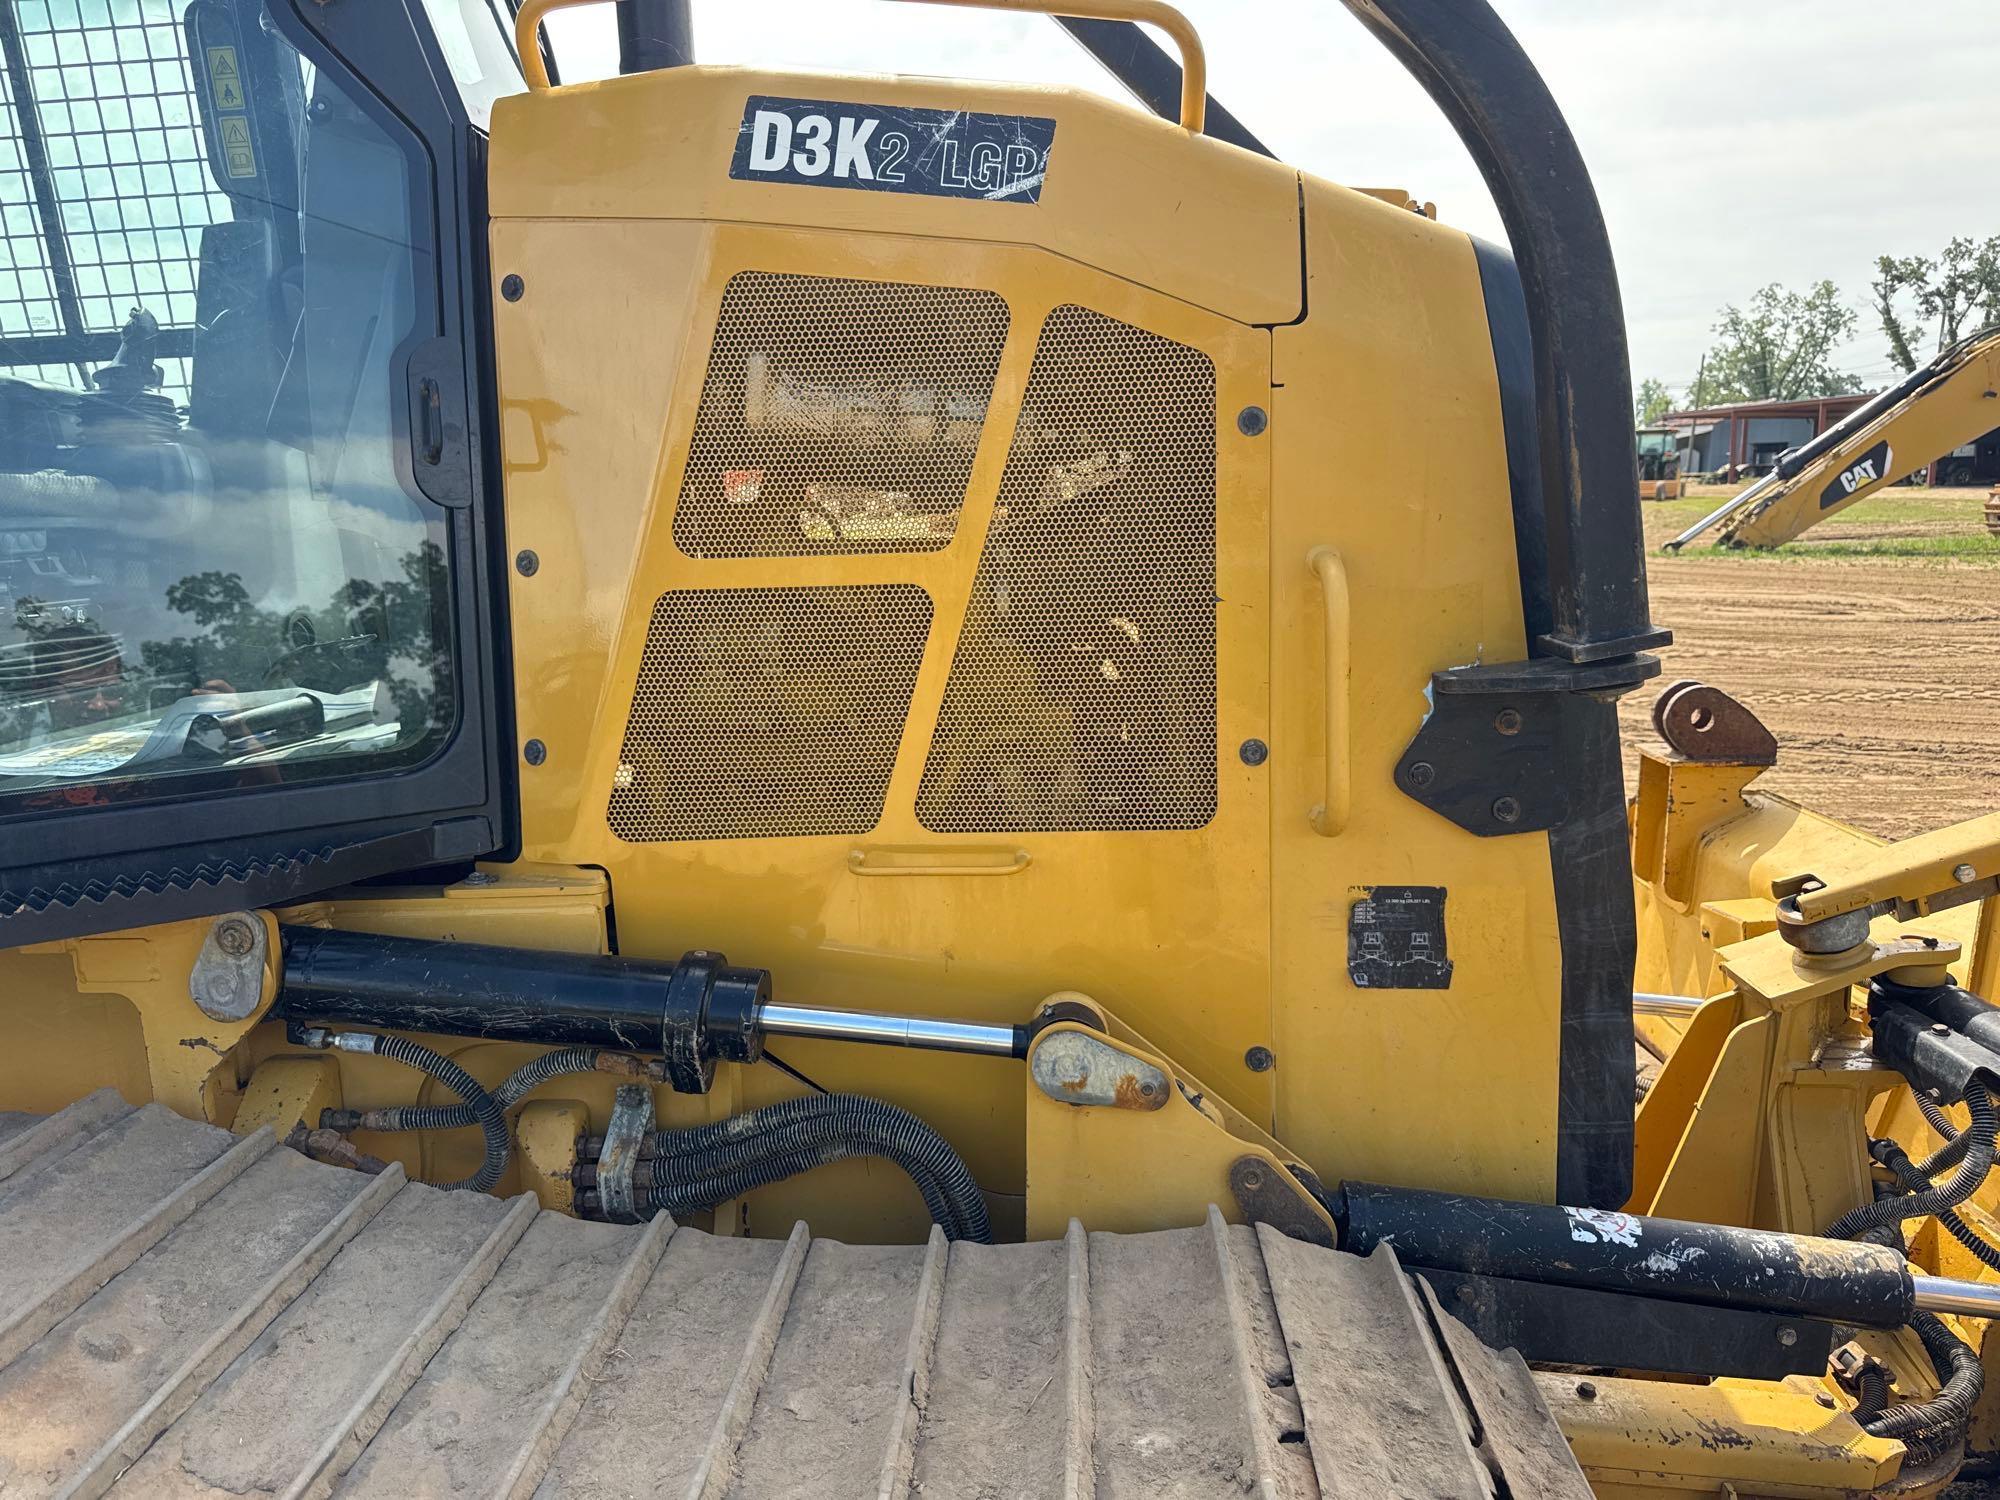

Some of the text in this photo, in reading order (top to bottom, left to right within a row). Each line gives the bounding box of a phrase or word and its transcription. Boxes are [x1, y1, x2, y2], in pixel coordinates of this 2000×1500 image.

[748, 109, 1038, 192] D3K2 LGP
[1839, 458, 1878, 493] CAT
